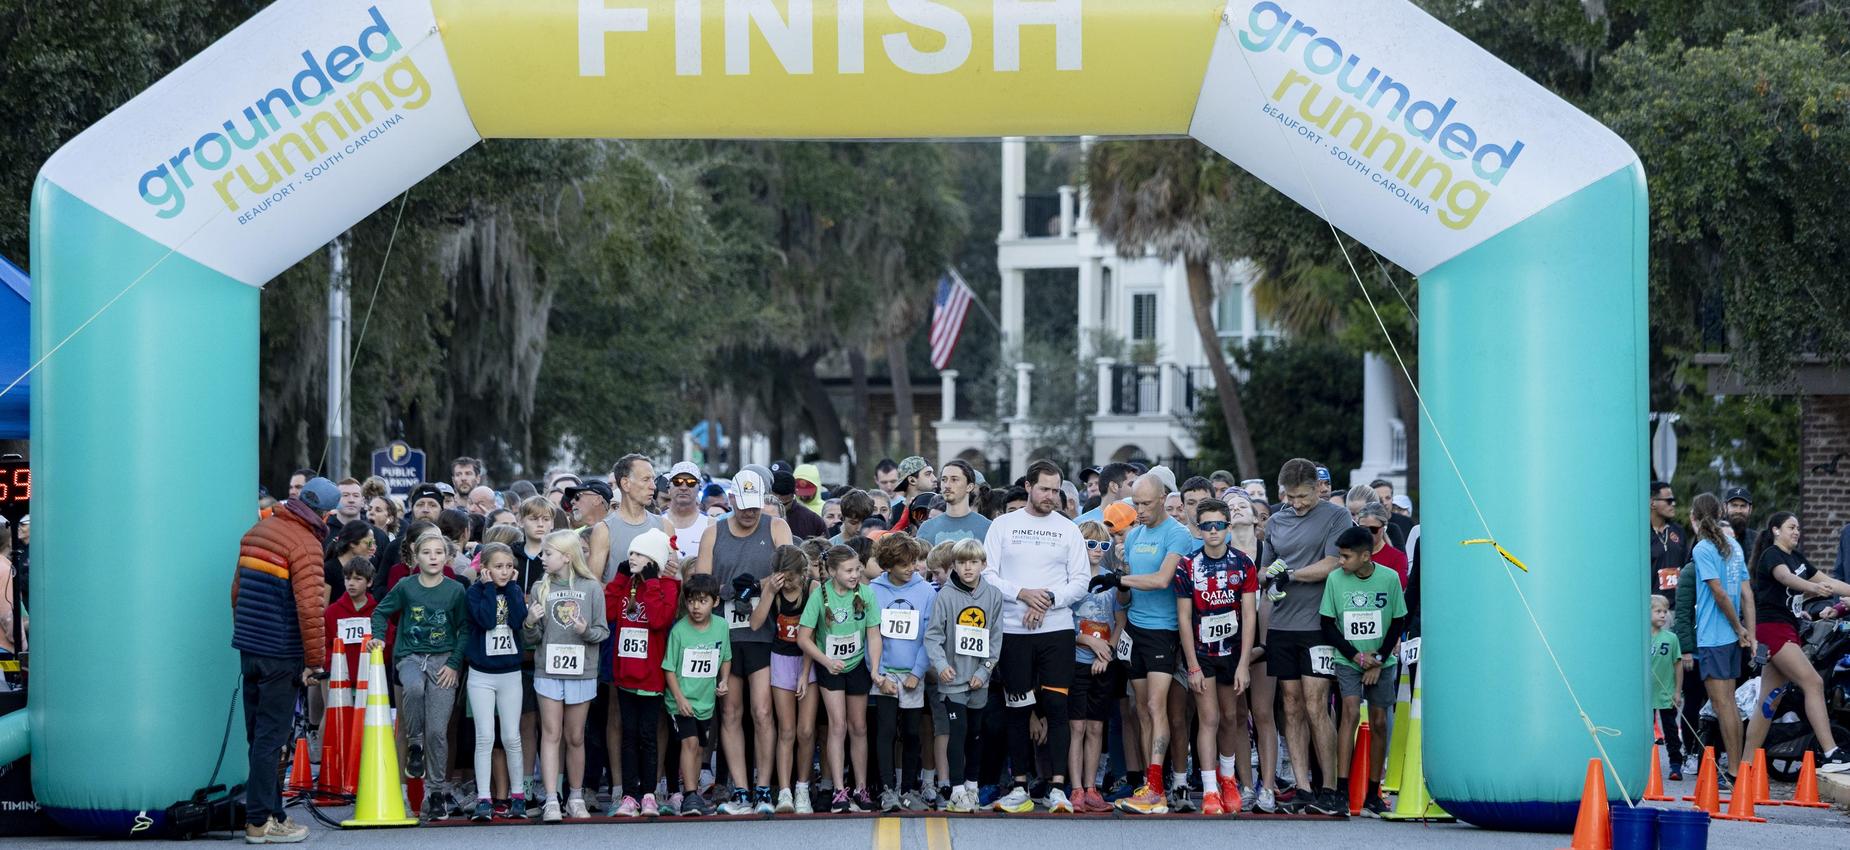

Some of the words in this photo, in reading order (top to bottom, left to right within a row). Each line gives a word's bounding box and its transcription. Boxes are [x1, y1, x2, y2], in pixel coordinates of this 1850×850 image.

[578, 0, 1082, 76] FINISH
[1238, 1, 1525, 186] grounded
[138, 5, 403, 219] grounded
[211, 55, 431, 212] running
[1271, 68, 1492, 230] running
[1262, 103, 1323, 145] BEAUFORT
[1330, 146, 1370, 177] SOUTH
[1371, 172, 1430, 215] CAROLINA
[237, 182, 297, 225] BEAUFORT
[304, 152, 343, 182] SOUTH
[344, 112, 404, 155] CAROLINA
[381, 467, 417, 477] PUBLIC
[1012, 529, 1063, 539] PINEHURST
[1201, 589, 1235, 602] QATAR
[1210, 598, 1235, 606] AIRWAYS
[345, 626, 364, 639] 779
[889, 620, 911, 634] 767
[1208, 622, 1232, 638] 796
[1350, 621, 1376, 635] 852
[492, 635, 512, 650] 723
[623, 638, 648, 653] 853
[833, 642, 856, 656] 795
[960, 636, 983, 652] 828
[1404, 647, 1418, 661] 747
[553, 655, 578, 669] 824
[690, 660, 711, 673] 775
